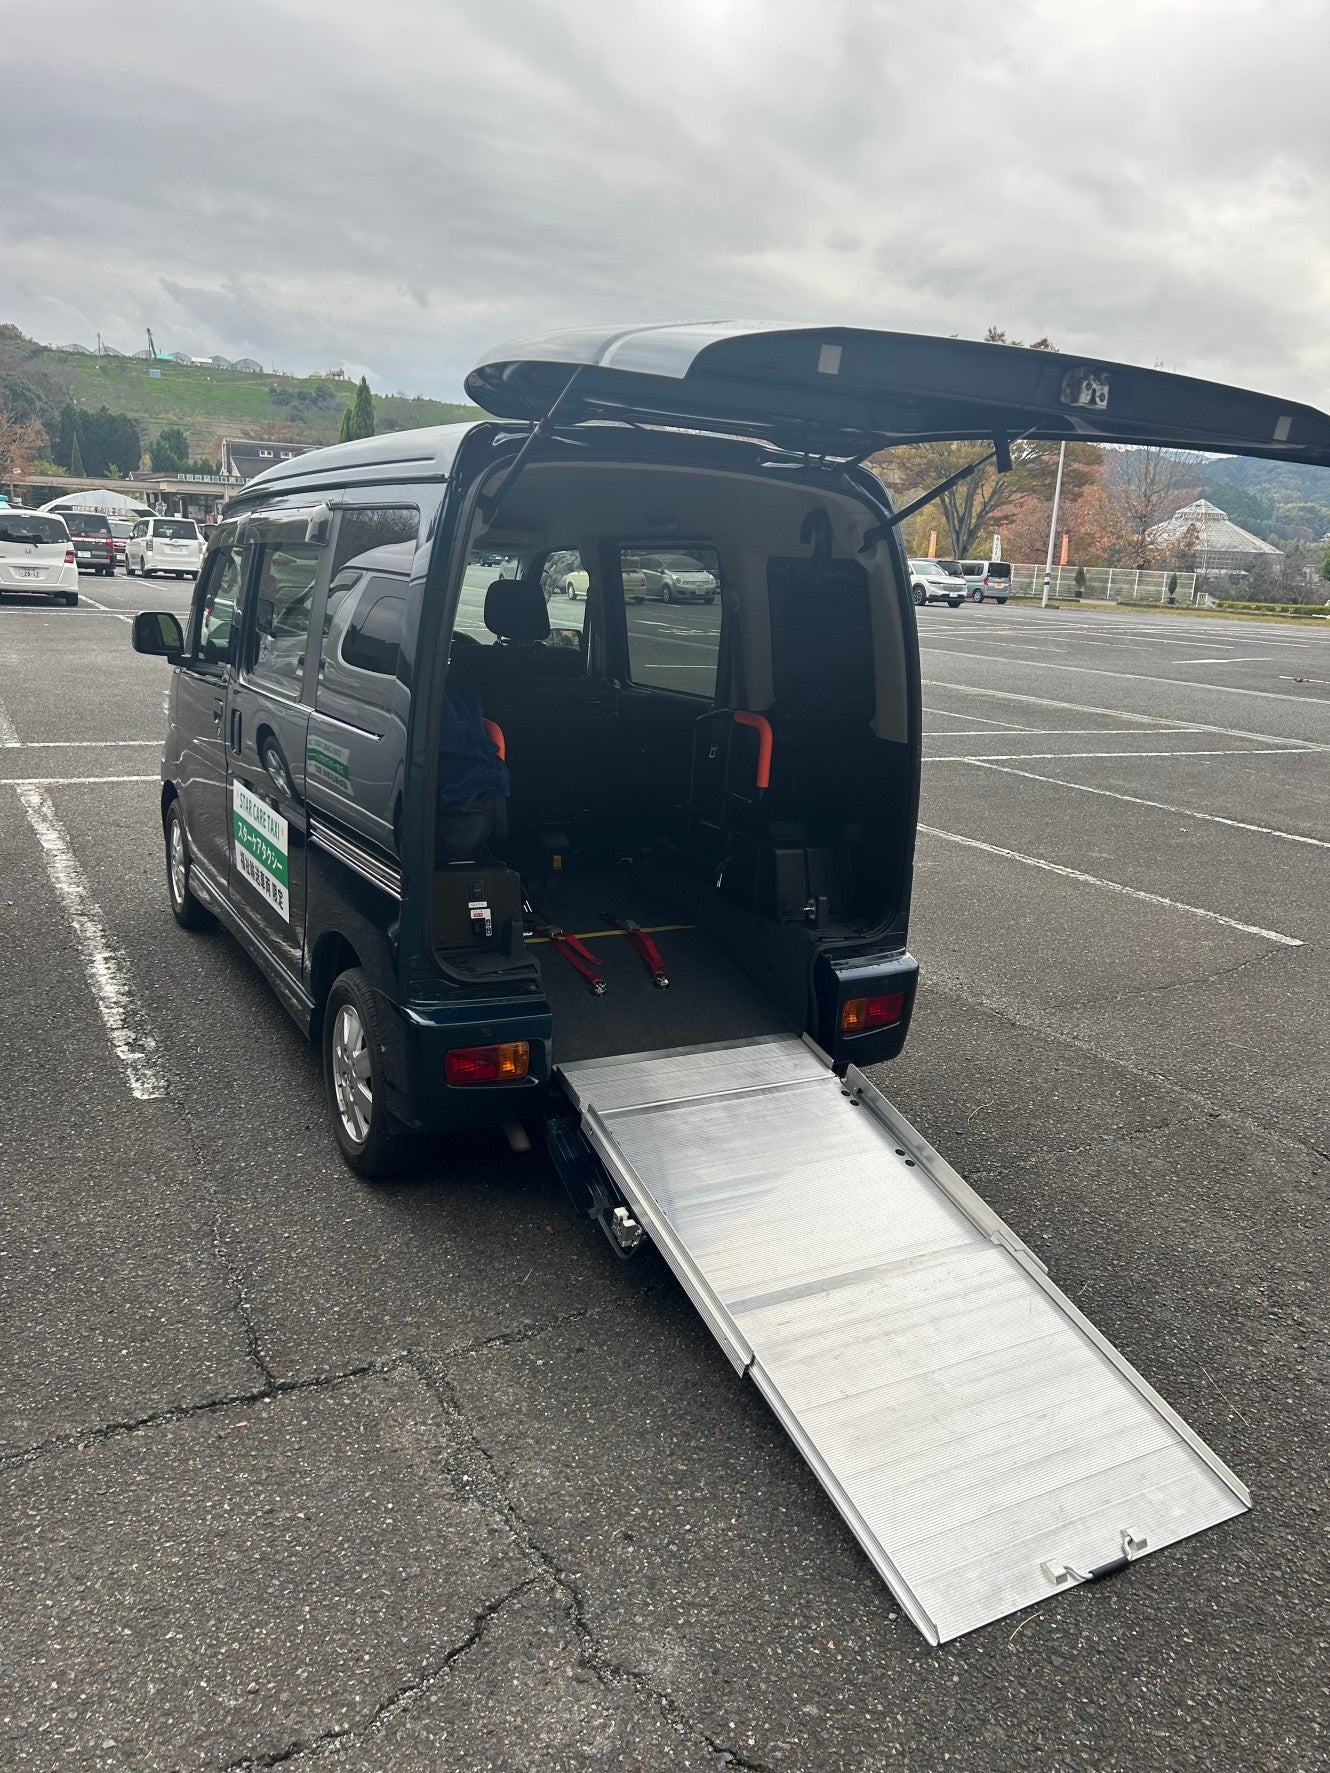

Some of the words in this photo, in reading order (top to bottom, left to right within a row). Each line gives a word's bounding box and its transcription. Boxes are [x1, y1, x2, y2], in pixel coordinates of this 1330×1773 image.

[239, 792, 253, 817] STAR
[253, 803, 266, 827] CARE
[266, 814, 280, 841] TAXI
[238, 821, 283, 870] スターケアタクシー
